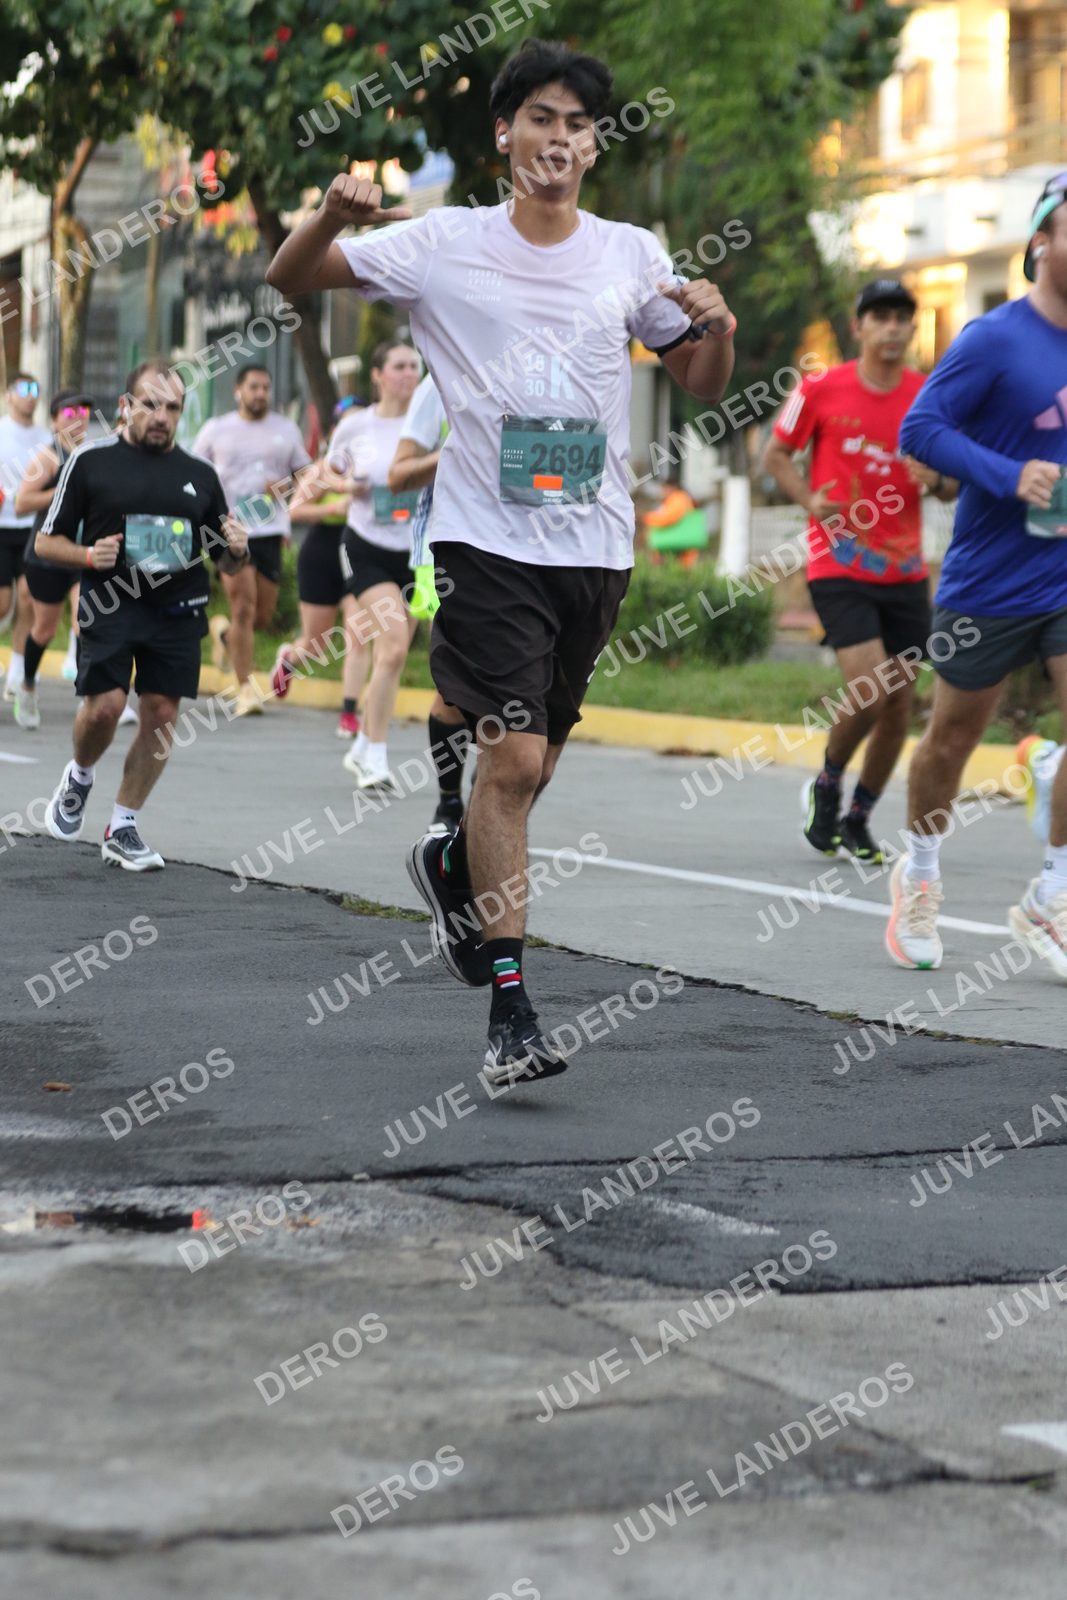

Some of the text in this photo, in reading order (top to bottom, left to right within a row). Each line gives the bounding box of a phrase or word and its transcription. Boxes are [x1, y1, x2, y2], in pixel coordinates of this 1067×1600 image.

[526, 378, 545, 397] 30
[550, 355, 576, 400] K
[529, 443, 601, 477] 2694
